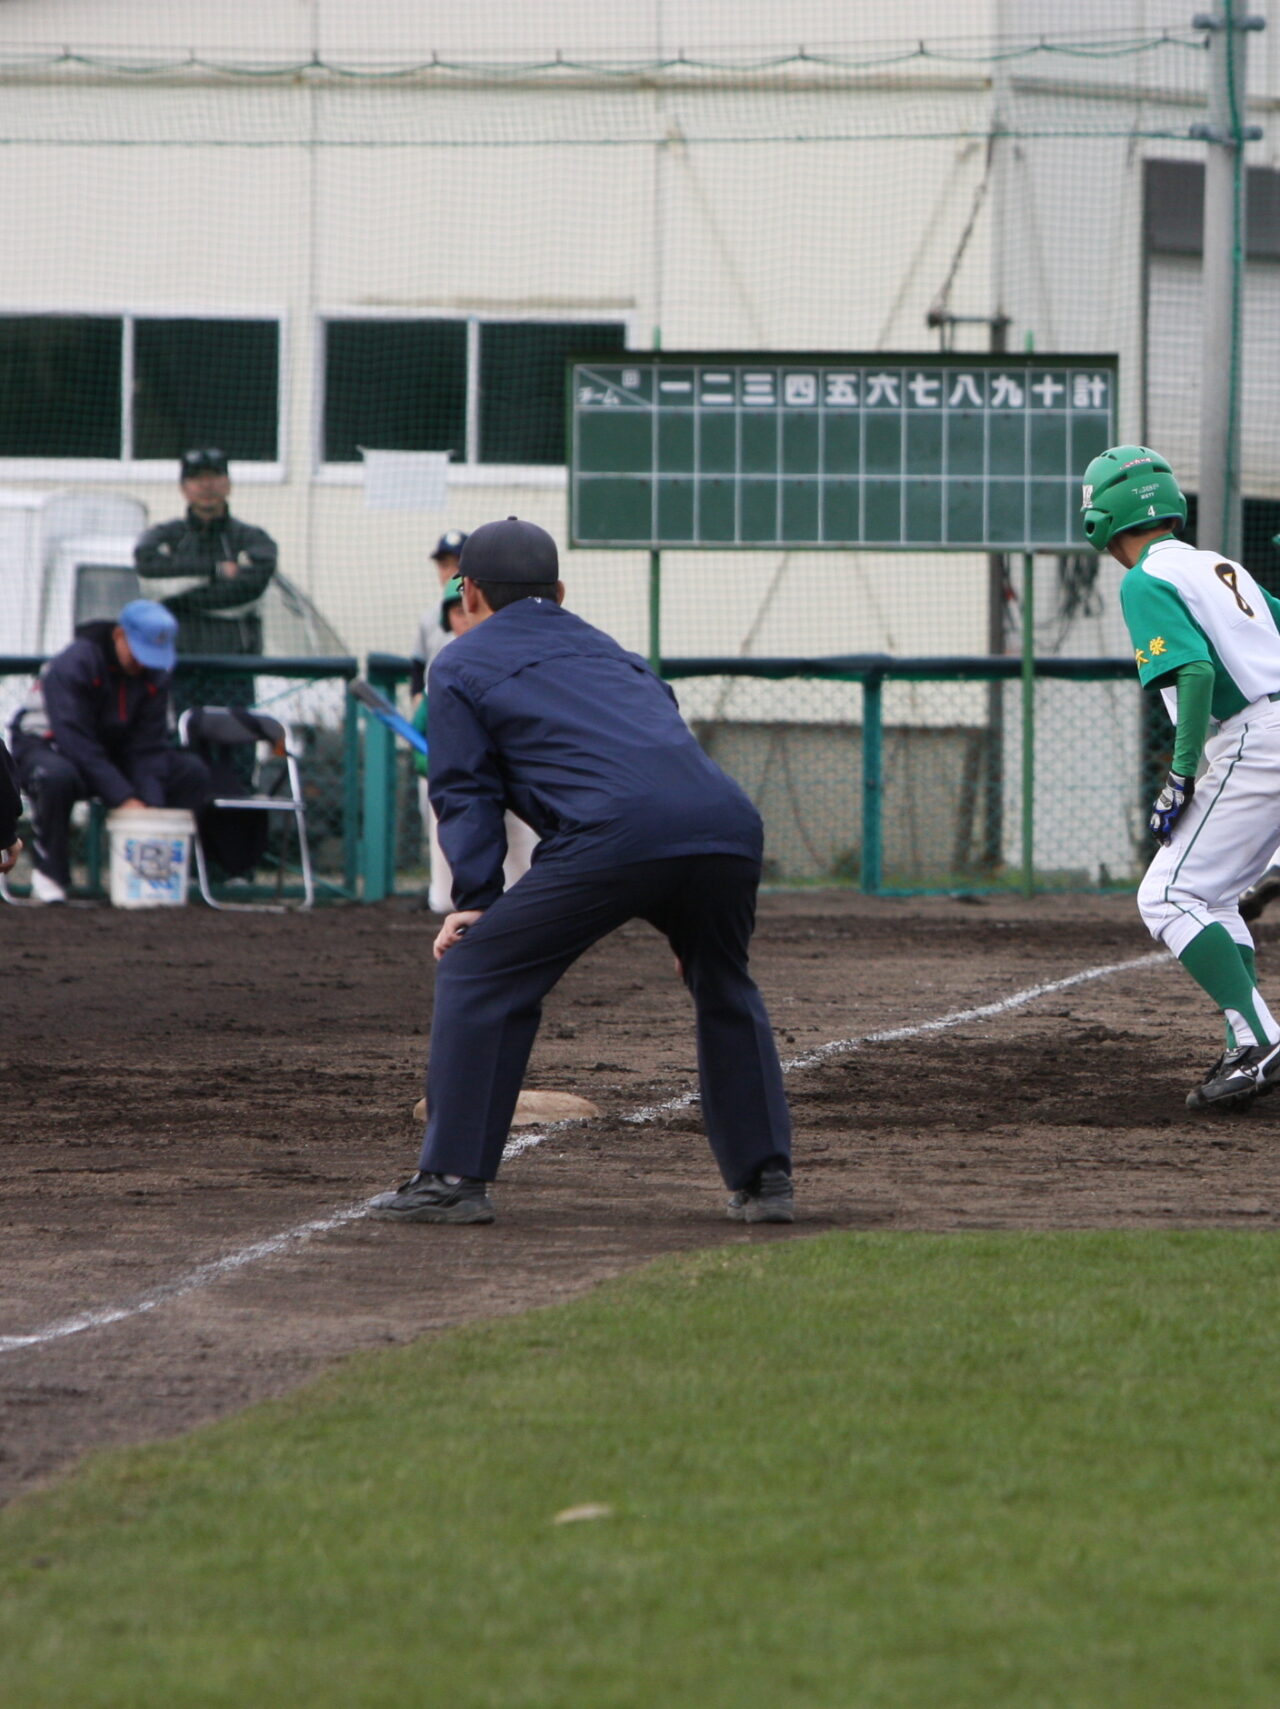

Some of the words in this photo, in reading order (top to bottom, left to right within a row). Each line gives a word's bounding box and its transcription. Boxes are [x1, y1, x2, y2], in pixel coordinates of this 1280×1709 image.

[578, 385, 620, 406] チーム
[660, 380, 692, 393] 一
[701, 373, 733, 404] 二
[743, 373, 775, 405] 三
[785, 373, 816, 406] 四
[825, 373, 858, 406] 五
[866, 372, 899, 407] 六
[908, 373, 940, 407] 七
[949, 374, 983, 407] 八
[991, 374, 1023, 408] 九
[1032, 374, 1064, 408] 十
[1073, 374, 1106, 408] 計
[1146, 504, 1156, 517] 4
